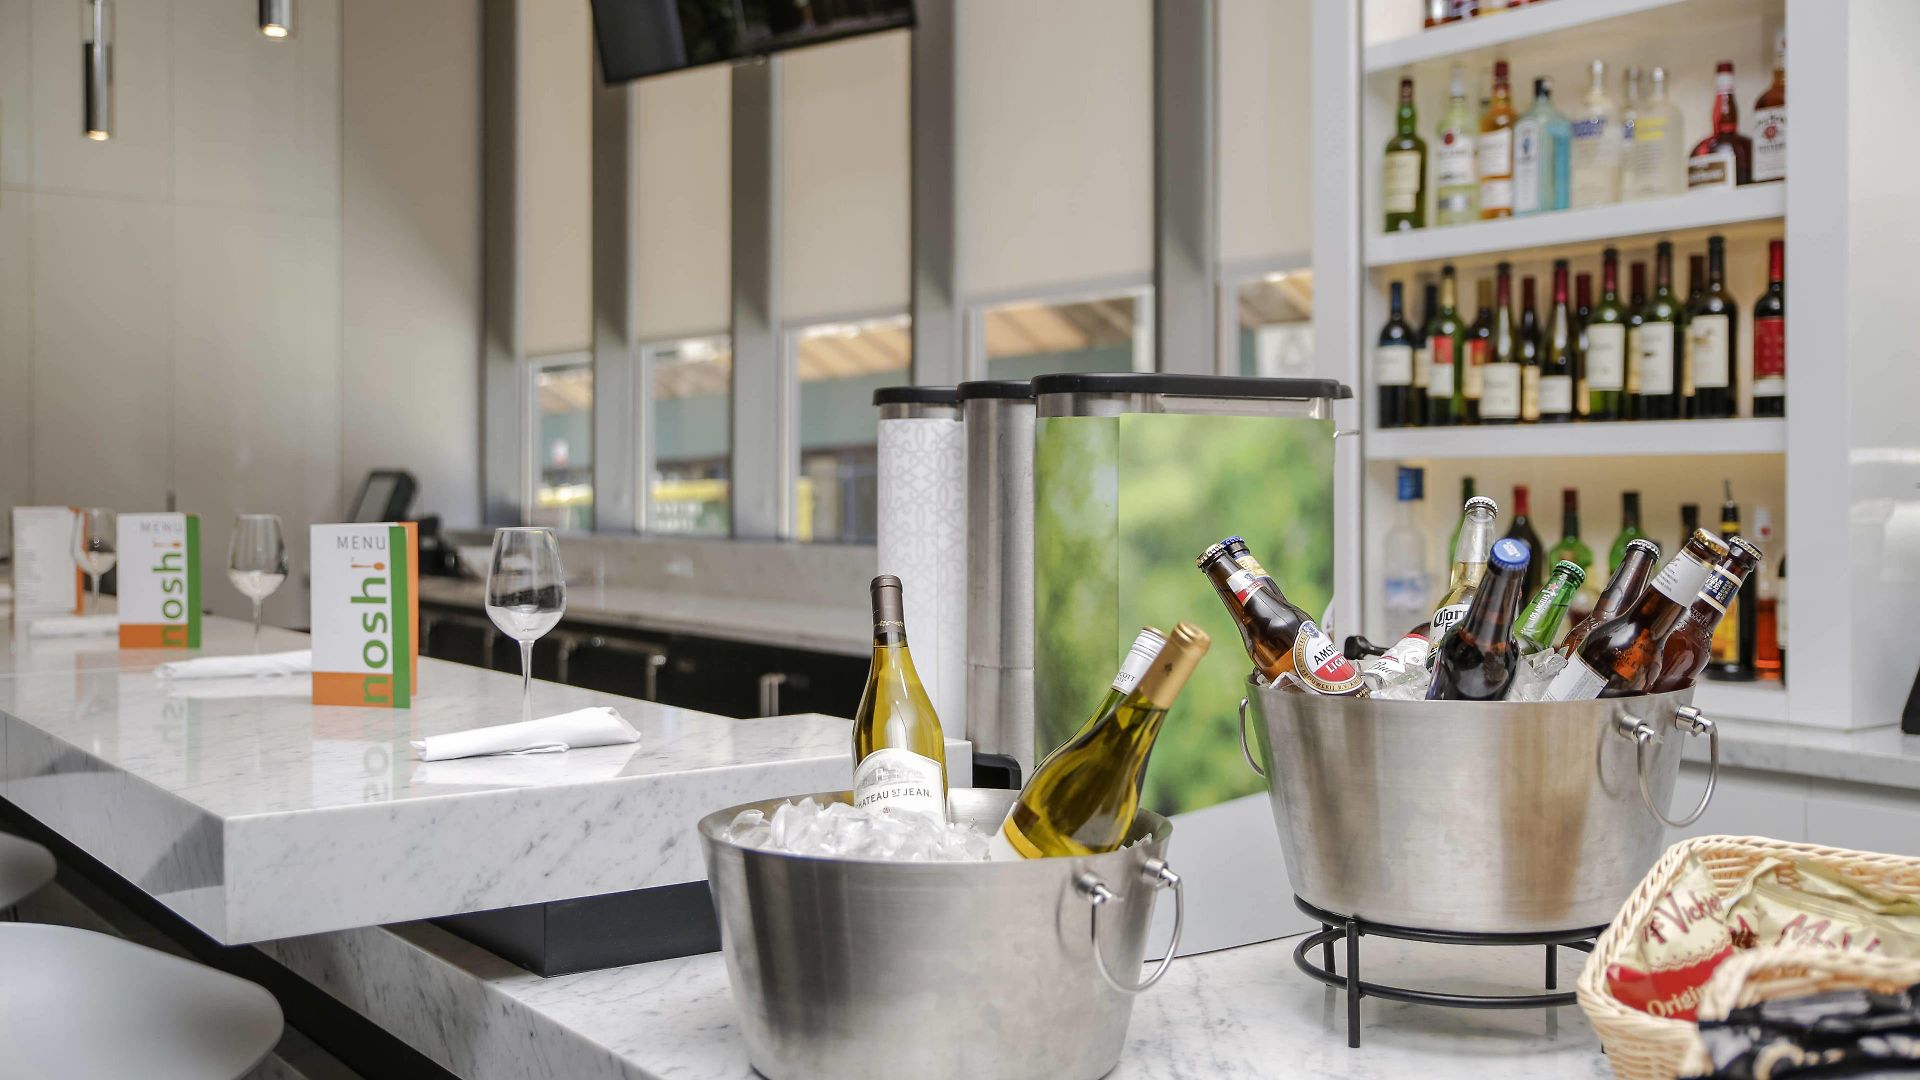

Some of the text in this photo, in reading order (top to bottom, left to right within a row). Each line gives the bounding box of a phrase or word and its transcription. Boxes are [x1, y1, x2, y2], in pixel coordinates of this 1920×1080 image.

[140, 521, 183, 533] MENU
[336, 535, 387, 551] MENU
[1313, 643, 1339, 666] AMSTE
[1325, 655, 1348, 673] LIGH
